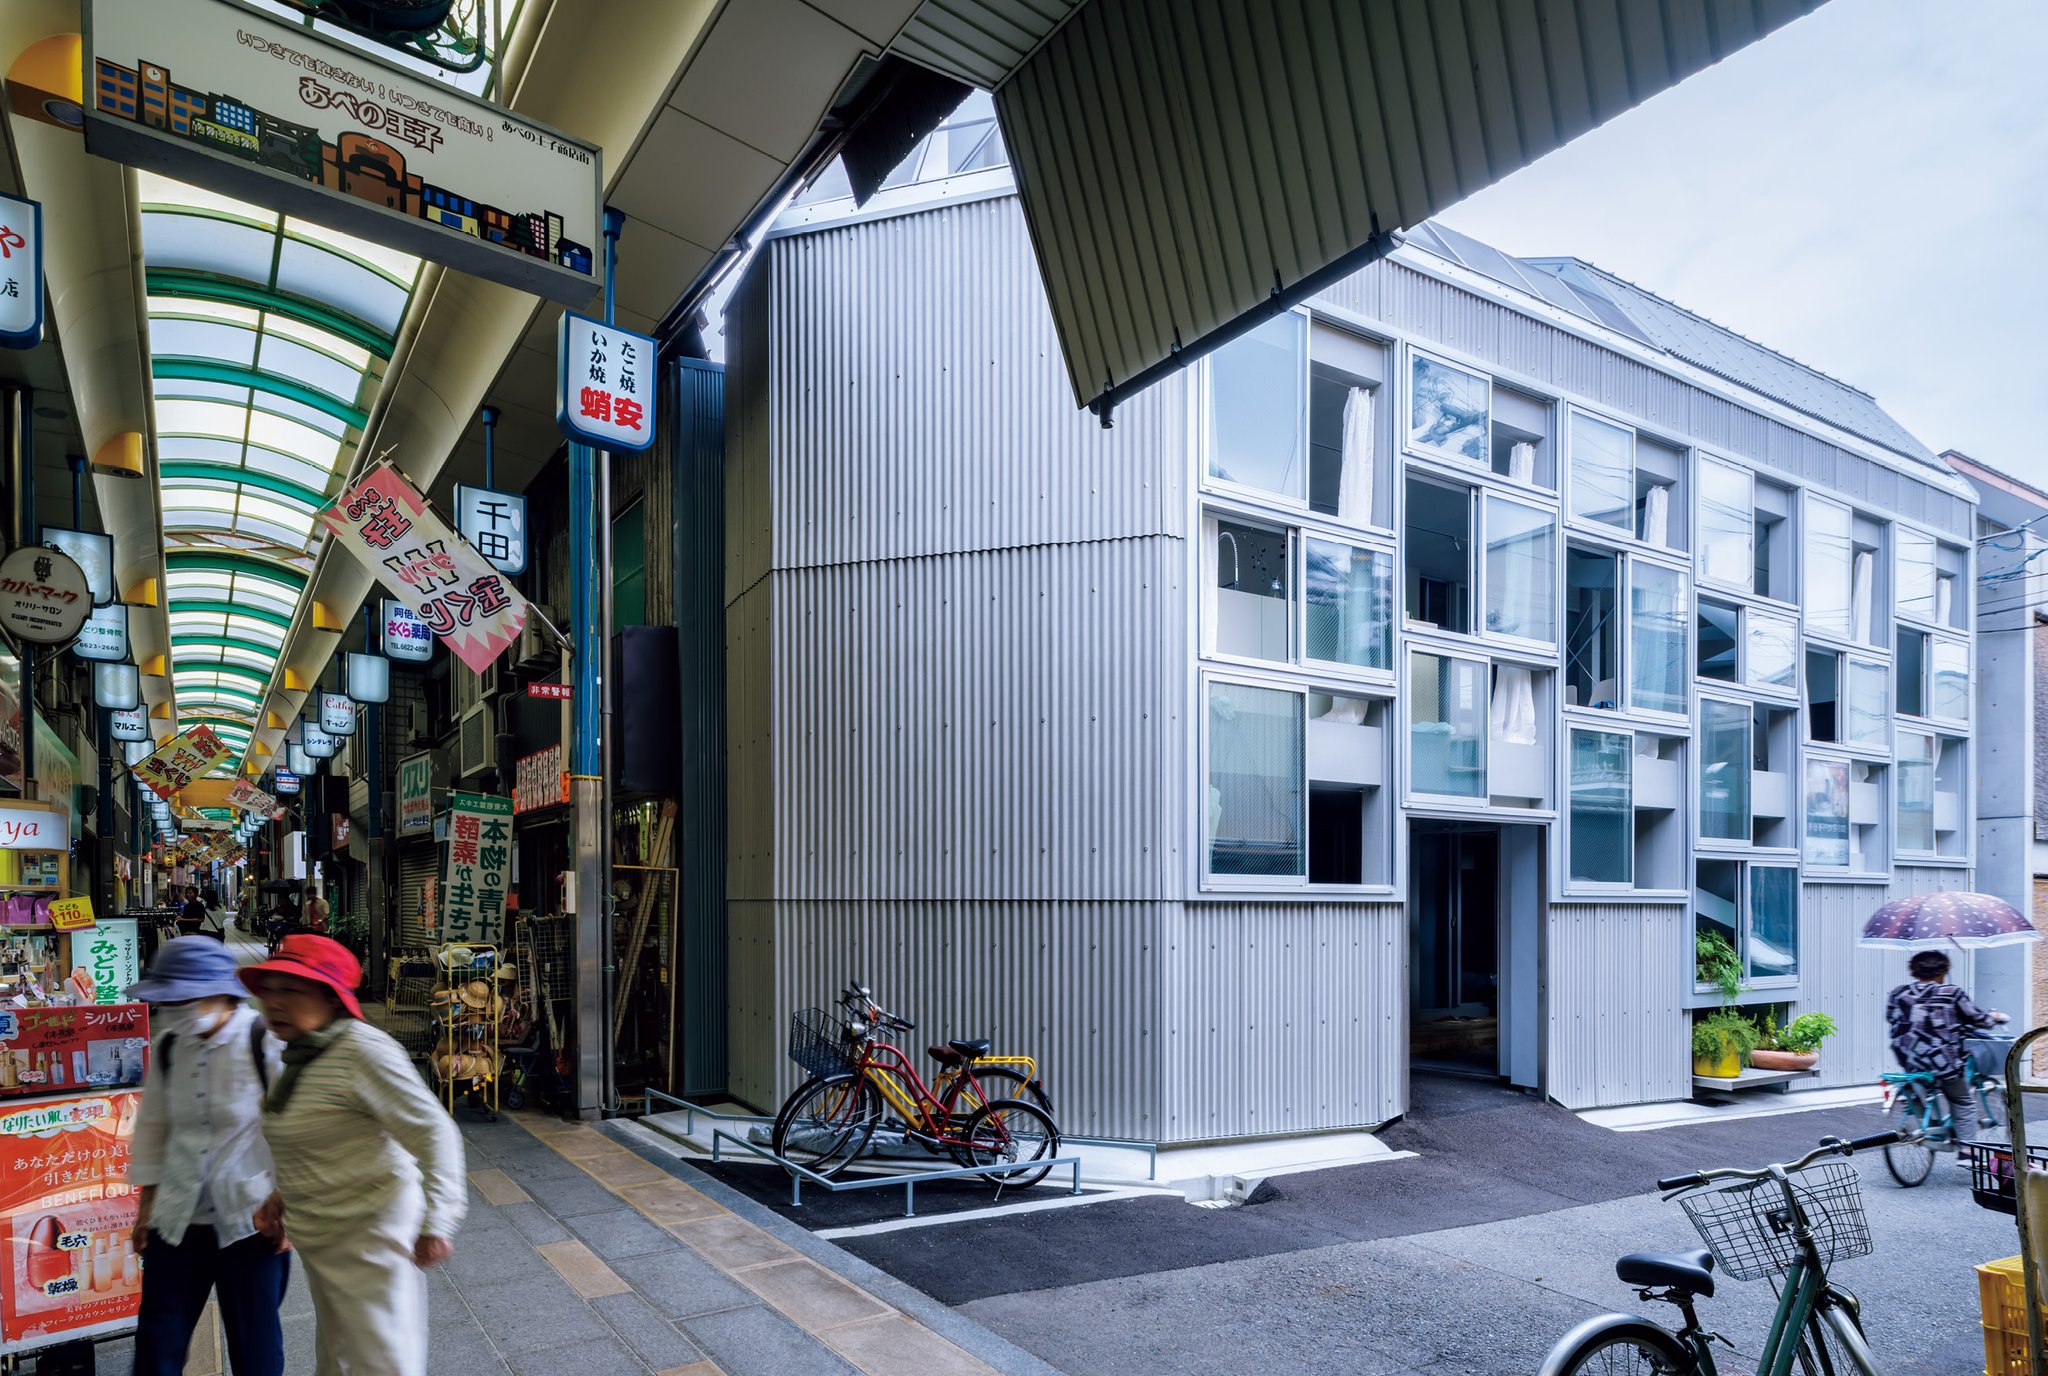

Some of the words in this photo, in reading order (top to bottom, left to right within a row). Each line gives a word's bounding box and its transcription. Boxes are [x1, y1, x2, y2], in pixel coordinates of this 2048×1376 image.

[299, 76, 444, 153] あべの王子
[502, 120, 589, 165] あべの王子商店街
[0, 277, 19, 298] 店
[590, 330, 607, 384] いか焼
[620, 341, 636, 394] たこ焼
[581, 386, 643, 431] 蛸安
[477, 500, 511, 561] 千田
[1, 578, 79, 604] カバーマーク
[388, 620, 431, 641] さくら薬局
[391, 642, 400, 650] TEL
[530, 685, 571, 697] 非常警報
[325, 696, 354, 715] Cathy
[114, 722, 144, 731] マルエー
[306, 738, 332, 746] シンデレラ
[146, 757, 192, 788] 宝くじ
[403, 759, 429, 800] クスリ
[0, 821, 41, 845] ya
[58, 903, 79, 911] こども
[85, 1008, 142, 1025] シルバー
[41, 1184, 140, 1209] BENEFIQUE
[61, 1233, 88, 1248] 毛穴
[47, 1278, 78, 1295] 乾燥
